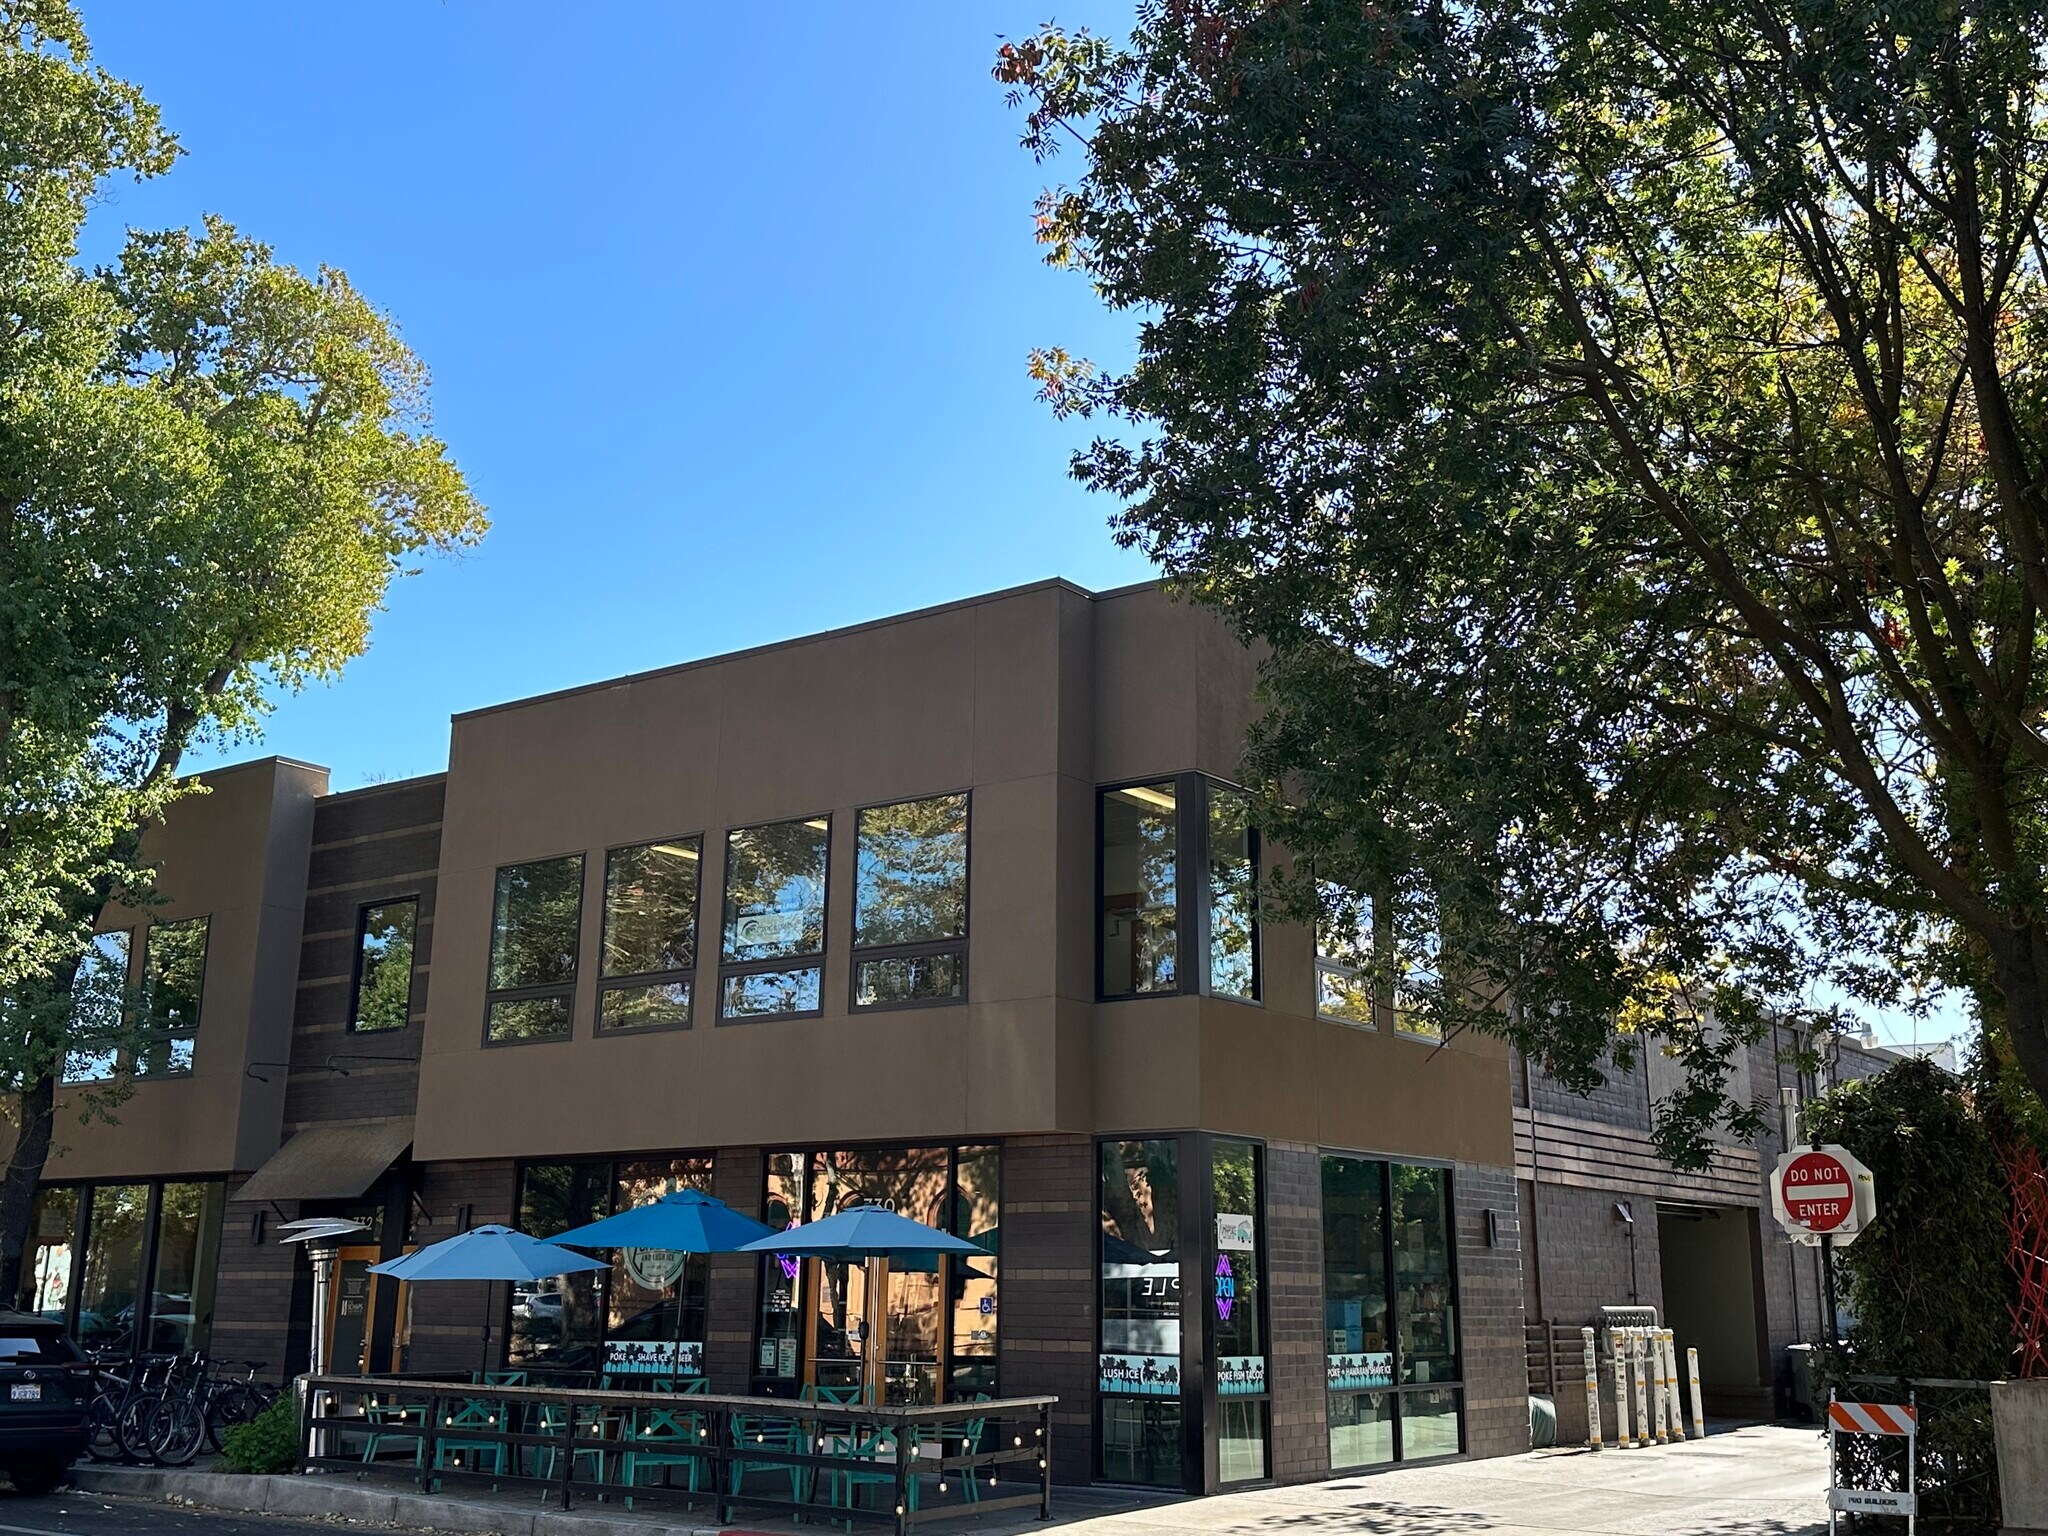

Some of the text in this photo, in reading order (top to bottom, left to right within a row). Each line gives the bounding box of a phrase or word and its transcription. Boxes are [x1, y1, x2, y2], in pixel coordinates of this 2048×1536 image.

[1791, 1167, 1840, 1181] DO NOT
[1799, 1202, 1839, 1216] ENTER
[610, 1352, 626, 1361] POKE
[637, 1353, 657, 1361] SHAVE
[1103, 1368, 1124, 1378] LUSH
[1217, 1371, 1233, 1381] POKE
[1246, 1370, 1264, 1380] TACOS
[1848, 1496, 1862, 1504] PRO
